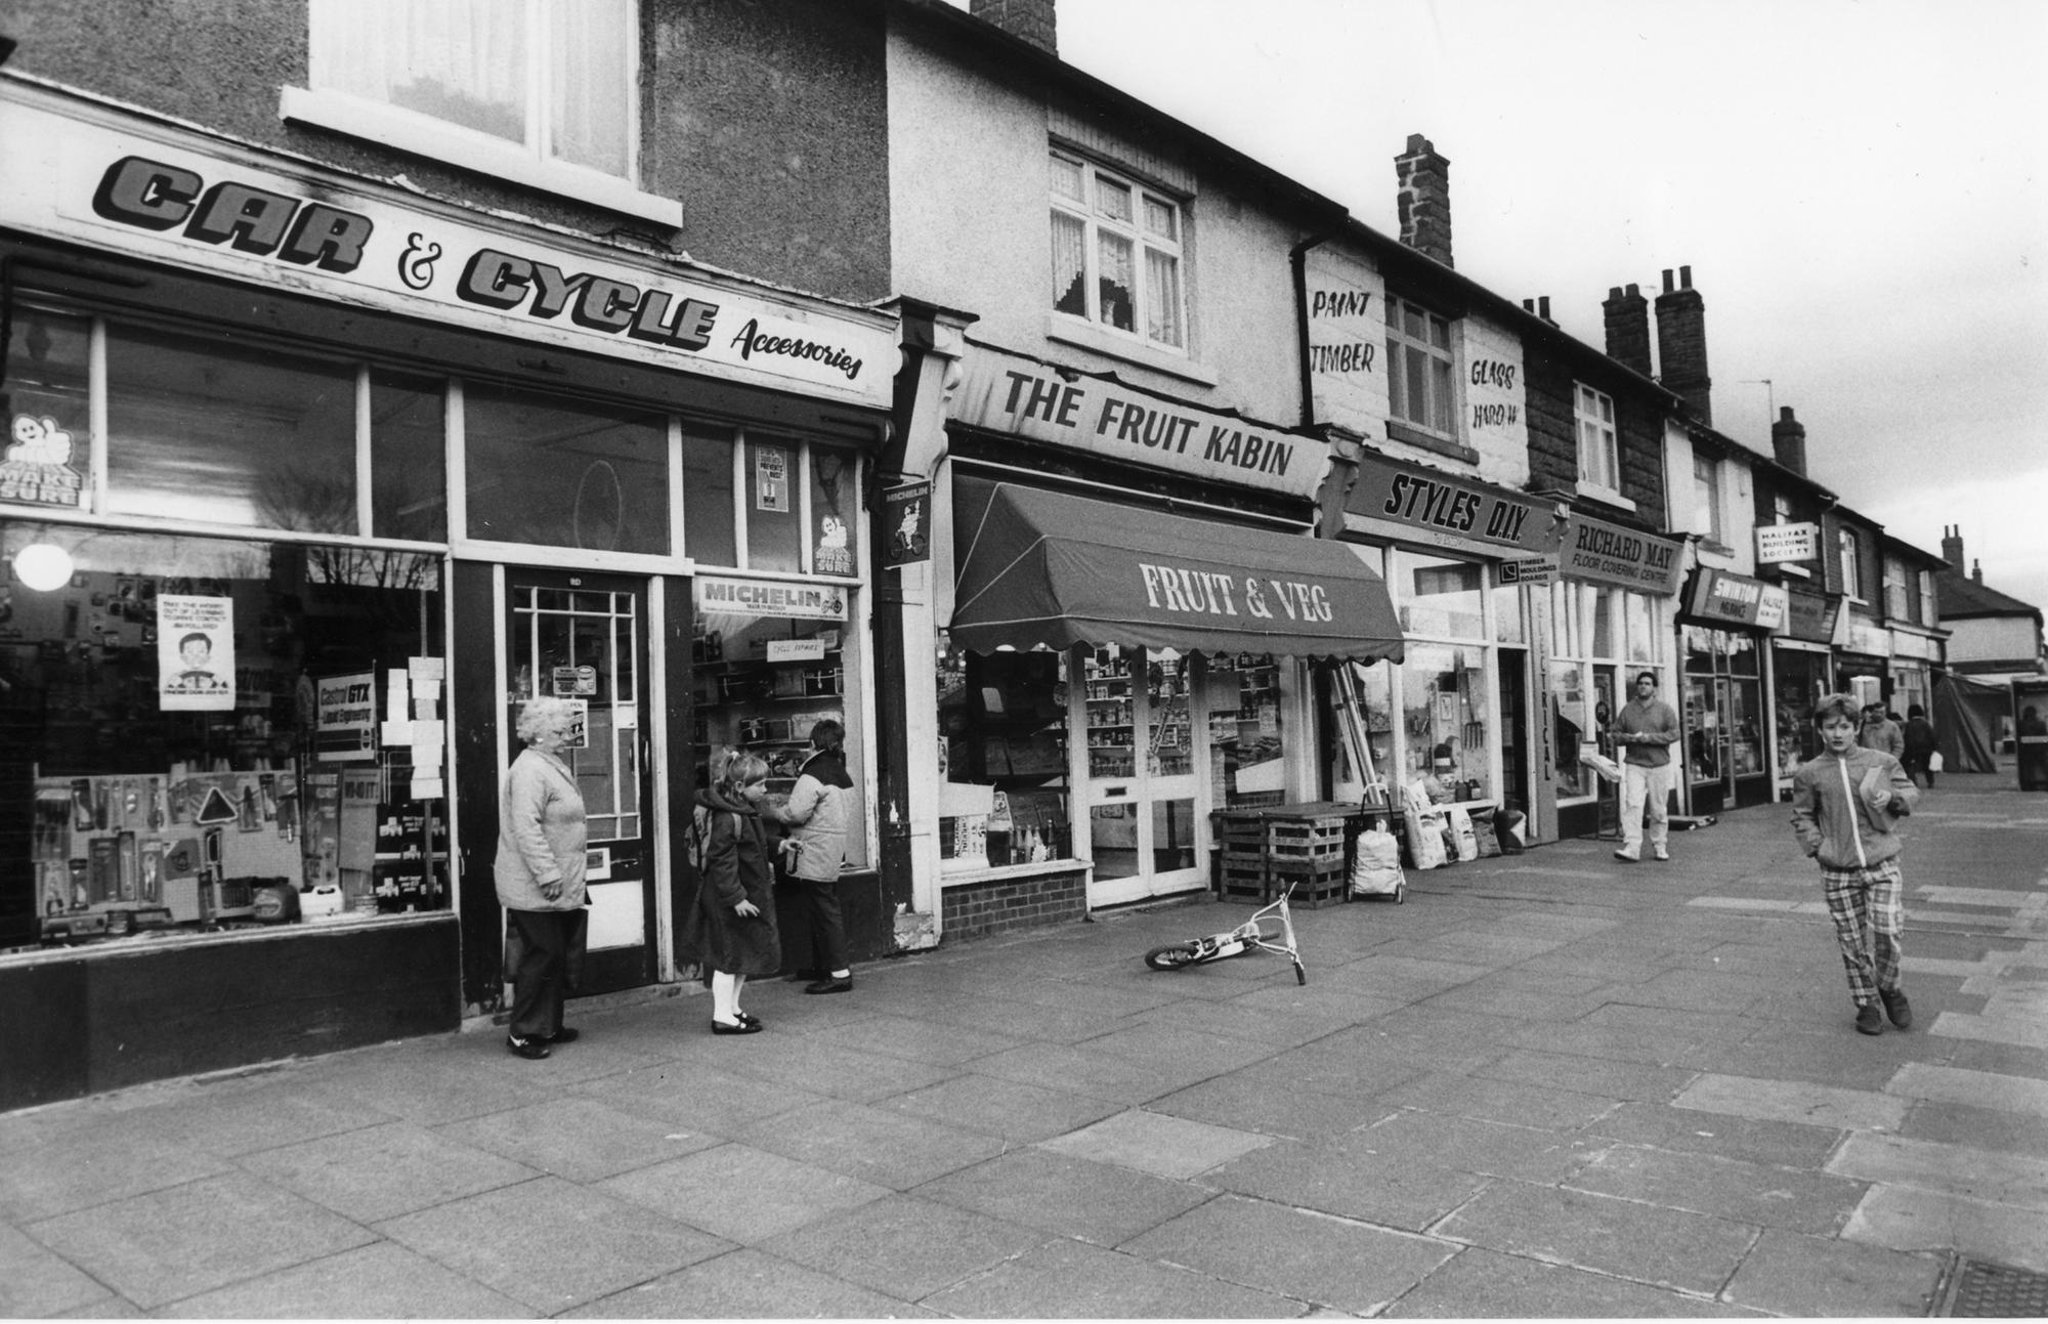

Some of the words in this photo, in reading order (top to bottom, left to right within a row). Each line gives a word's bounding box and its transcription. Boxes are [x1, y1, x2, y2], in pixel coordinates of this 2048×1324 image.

[92, 155, 374, 274] CAR
[397, 232, 442, 290] &
[456, 247, 720, 351] CYCLE
[731, 318, 863, 380] Accessories
[1311, 289, 1371, 319] PAINT
[1310, 343, 1375, 374] TIMBER
[1471, 359, 1516, 390] GLASS
[1004, 371, 1085, 428] THE
[1096, 396, 1200, 454] FRUIT
[1203, 424, 1295, 477] KABIN
[1383, 472, 1482, 533] STYLES
[1576, 524, 1642, 562] RICHARD
[1644, 543, 1673, 569] MAY
[1762, 529, 1808, 539] HALIFAX
[1572, 553, 1600, 569] FLOOR
[1601, 560, 1640, 578] COVERING
[704, 583, 821, 607] MICHELIN
[1138, 562, 1239, 616] FRUIT
[1245, 575, 1274, 619] &
[1272, 580, 1333, 622] VEG
[348, 683, 371, 704] GTX
